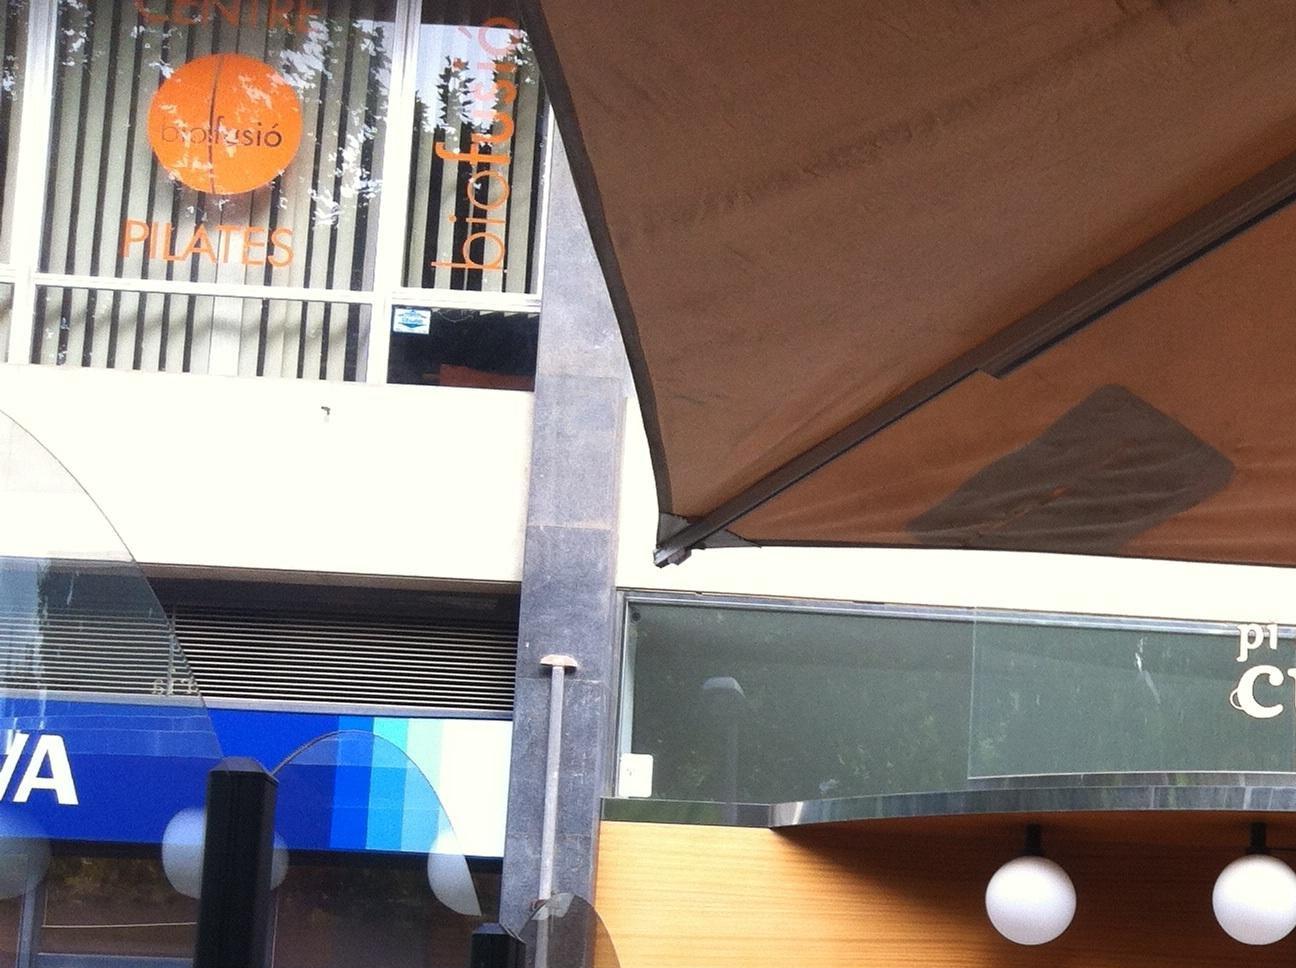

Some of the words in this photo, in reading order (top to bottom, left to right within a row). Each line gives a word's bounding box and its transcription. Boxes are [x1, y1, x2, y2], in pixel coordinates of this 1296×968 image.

[161, 115, 282, 147] bofusió
[431, 16, 522, 270] biofusió
[122, 217, 295, 268] PILATES
[1236, 619, 1278, 662] pi
